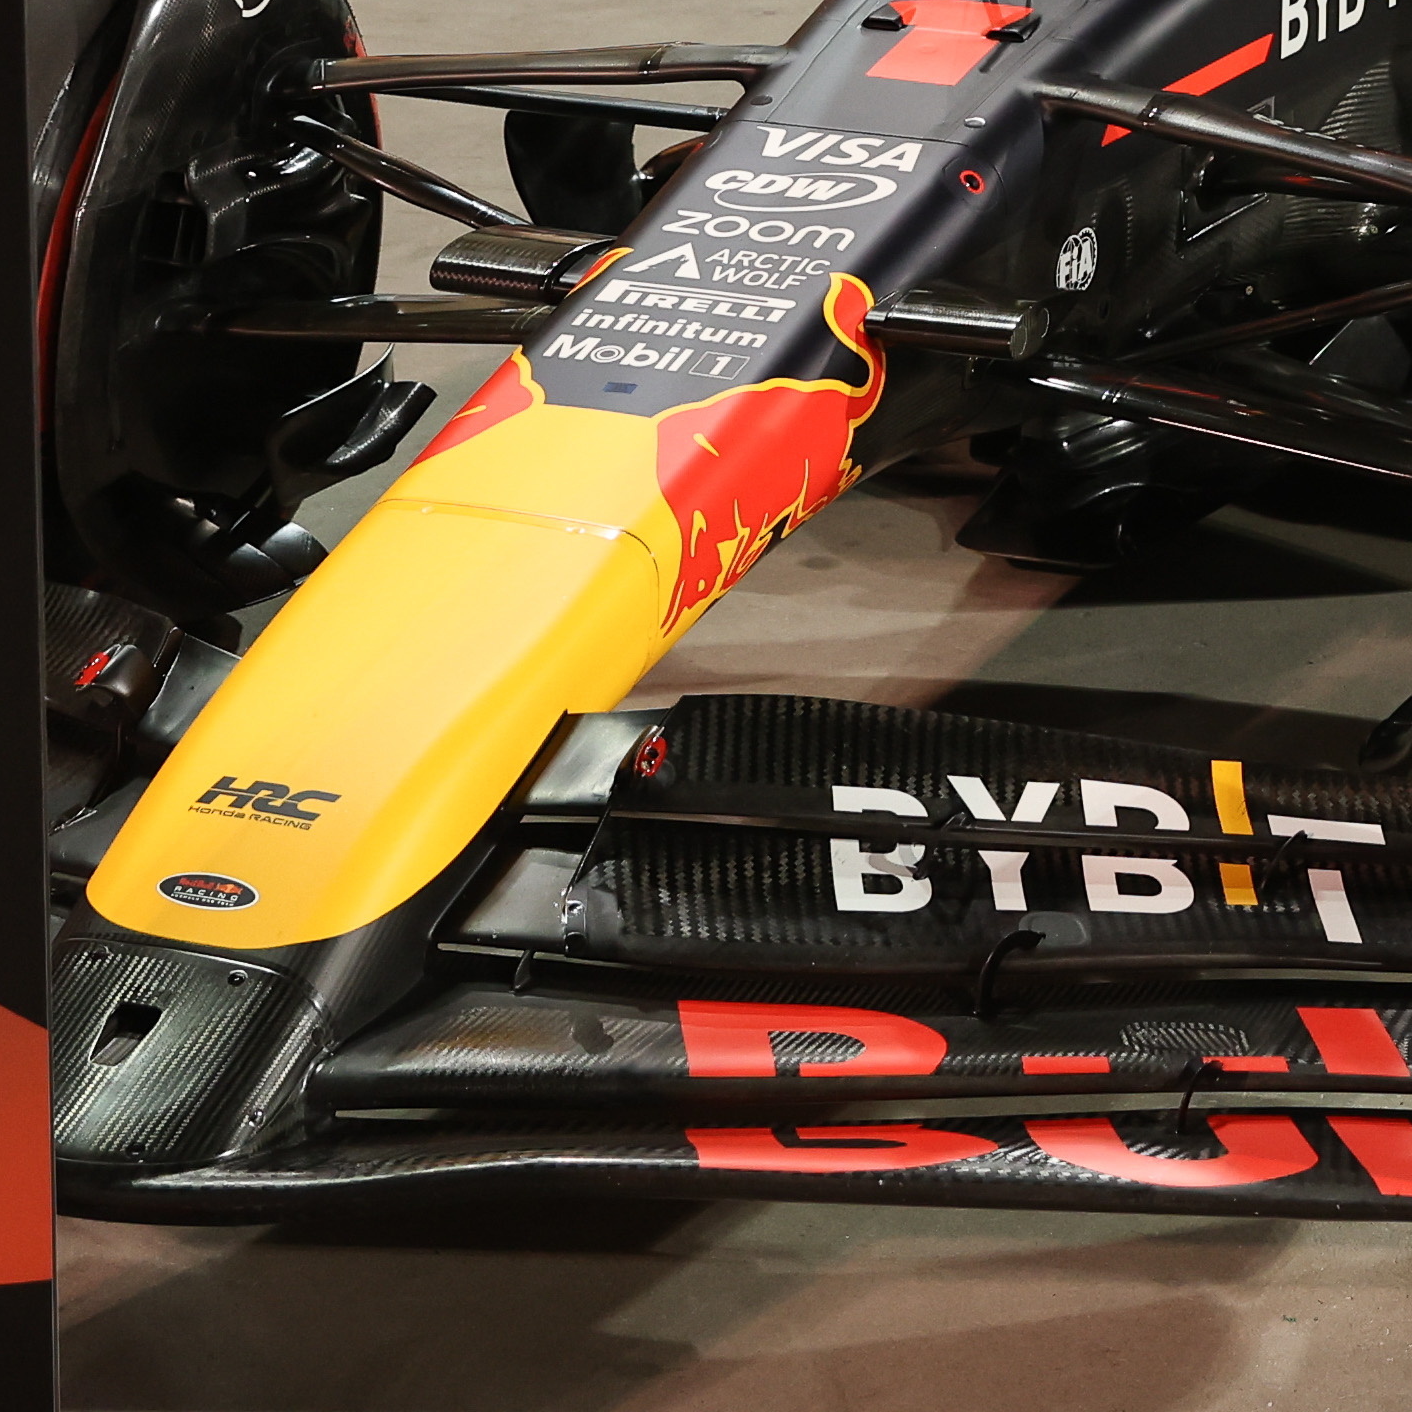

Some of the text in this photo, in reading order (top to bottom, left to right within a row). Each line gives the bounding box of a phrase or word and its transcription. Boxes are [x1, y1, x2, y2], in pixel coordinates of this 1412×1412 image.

[756, 125, 924, 173] VISA
[704, 168, 860, 205] CDW
[705, 248, 831, 276] ARCTIC
[710, 263, 806, 290] WOLF
[594, 279, 797, 323] PIRELLI
[571, 308, 768, 348] infinitum
[542, 333, 690, 373] Mobil
[188, 805, 313, 831] Honda RACING
[195, 775, 342, 822] HRC
[831, 759, 1385, 944] BYBIT
[174, 885, 239, 902] RACING
